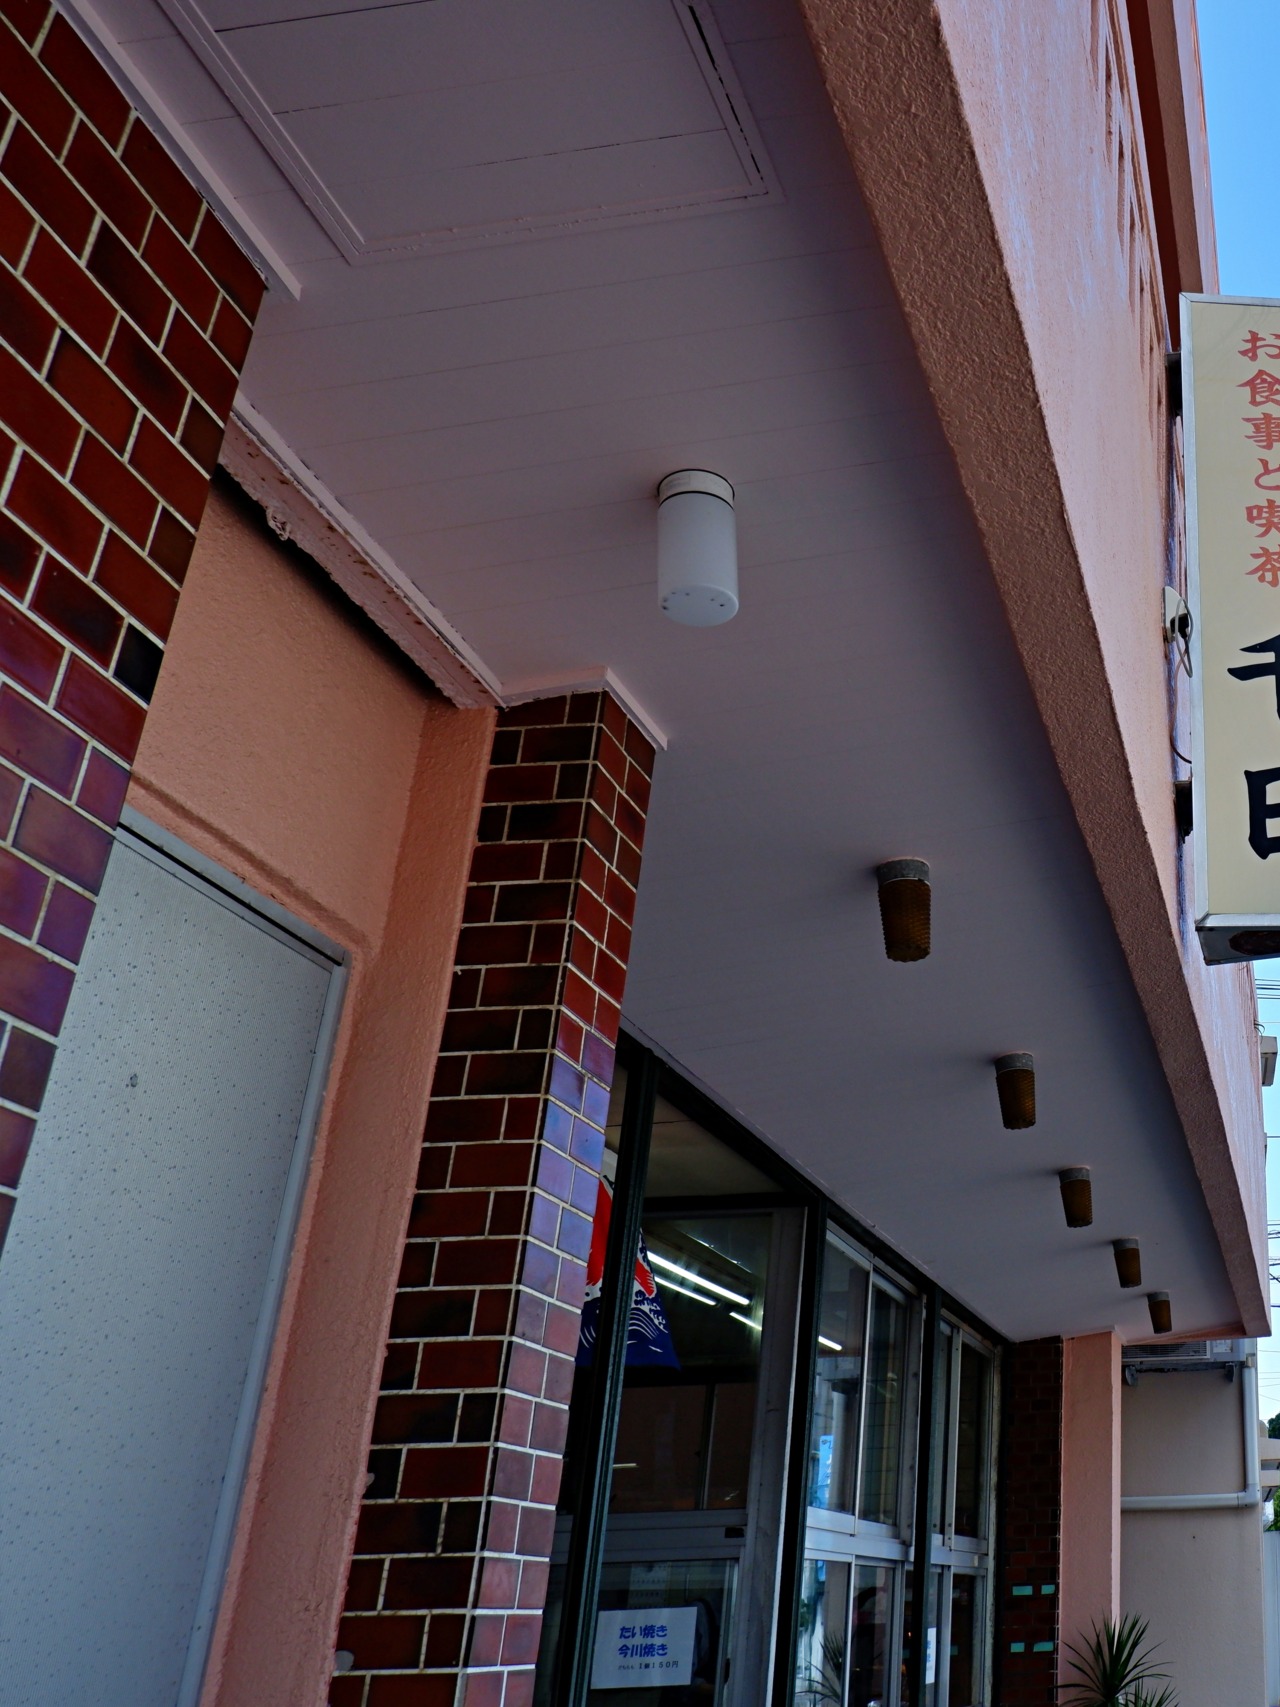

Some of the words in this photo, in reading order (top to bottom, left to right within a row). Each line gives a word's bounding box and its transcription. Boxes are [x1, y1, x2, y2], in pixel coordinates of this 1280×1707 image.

[619, 1624, 668, 1639] たい焼き
[618, 1643, 668, 1658] 今川焼き
